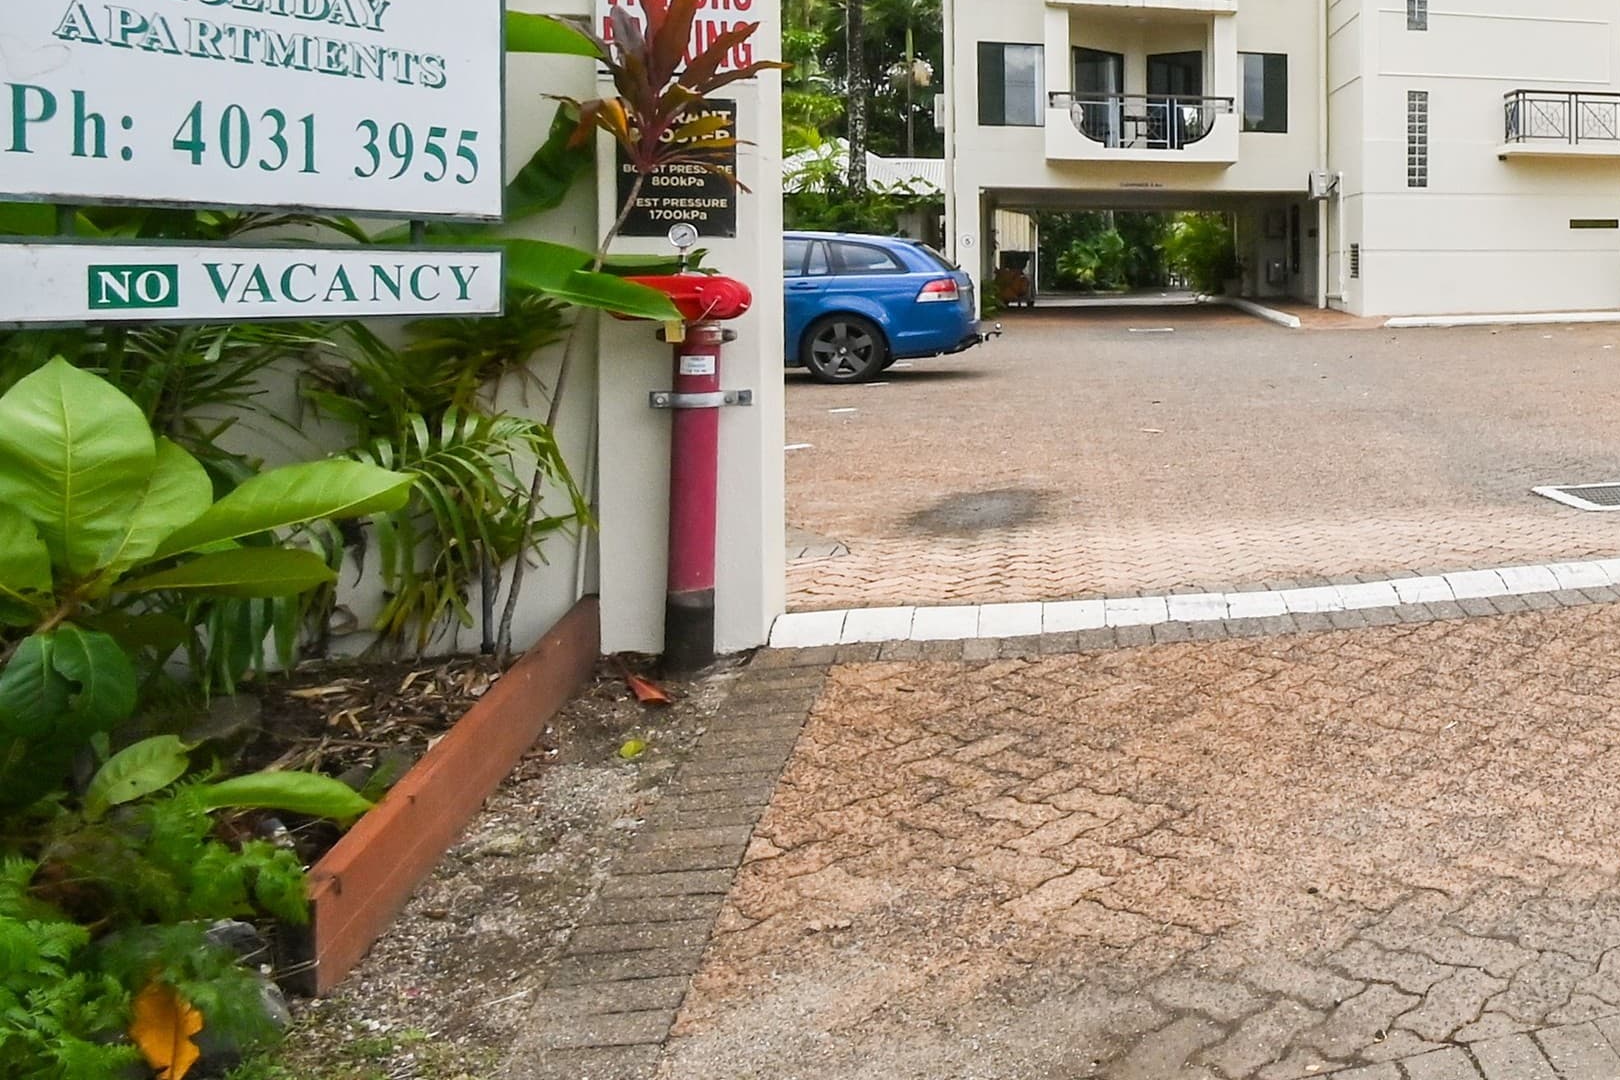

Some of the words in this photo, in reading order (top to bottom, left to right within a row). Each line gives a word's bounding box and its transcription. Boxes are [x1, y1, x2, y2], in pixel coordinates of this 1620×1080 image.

[52, 0, 447, 89] APARTMENTS
[3, 82, 134, 161] Ph:
[172, 100, 321, 175] 4031
[353, 118, 480, 185] 3955
[651, 176, 705, 187] 800kPa
[634, 198, 661, 208] EST
[662, 198, 729, 209] PRESSURE
[649, 209, 708, 221] 1700kPa
[97, 270, 171, 304] NO
[201, 263, 480, 304] VACANCY
